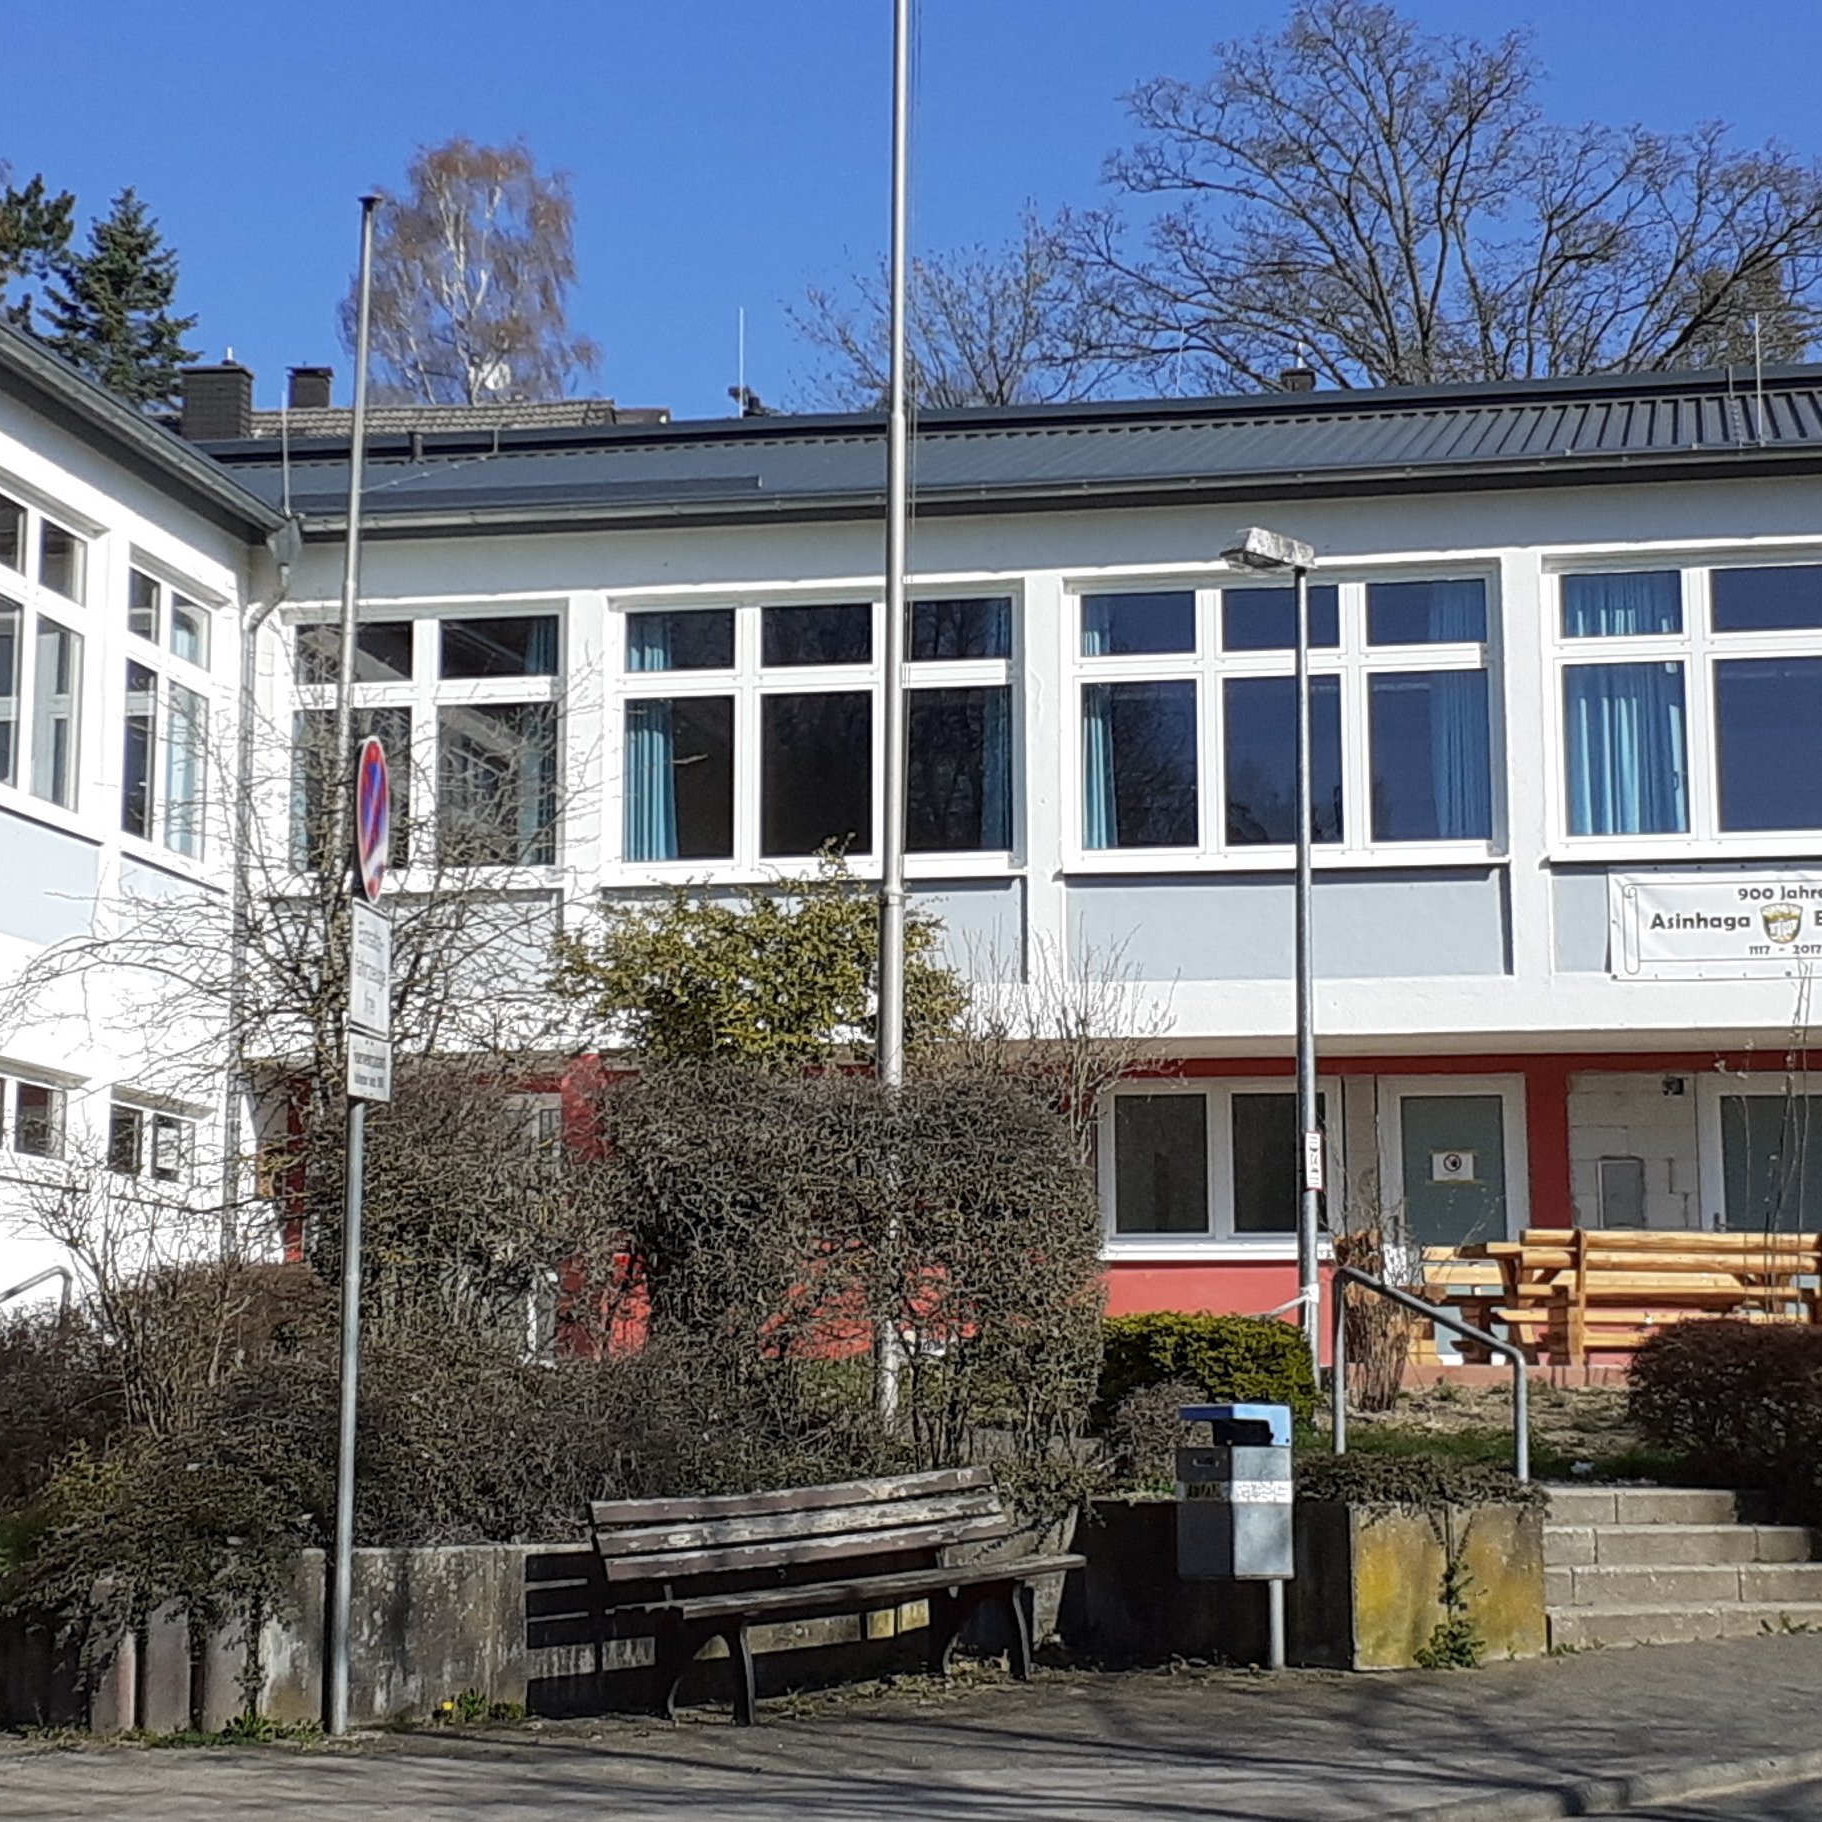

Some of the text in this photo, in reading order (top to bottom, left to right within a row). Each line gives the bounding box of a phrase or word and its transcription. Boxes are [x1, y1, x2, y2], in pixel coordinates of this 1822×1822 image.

[1737, 887, 1775, 901] 900
[1649, 912, 1752, 932] Asinhaga
[1748, 944, 1772, 956] 1117
[1792, 943, 1822, 956] 2017
